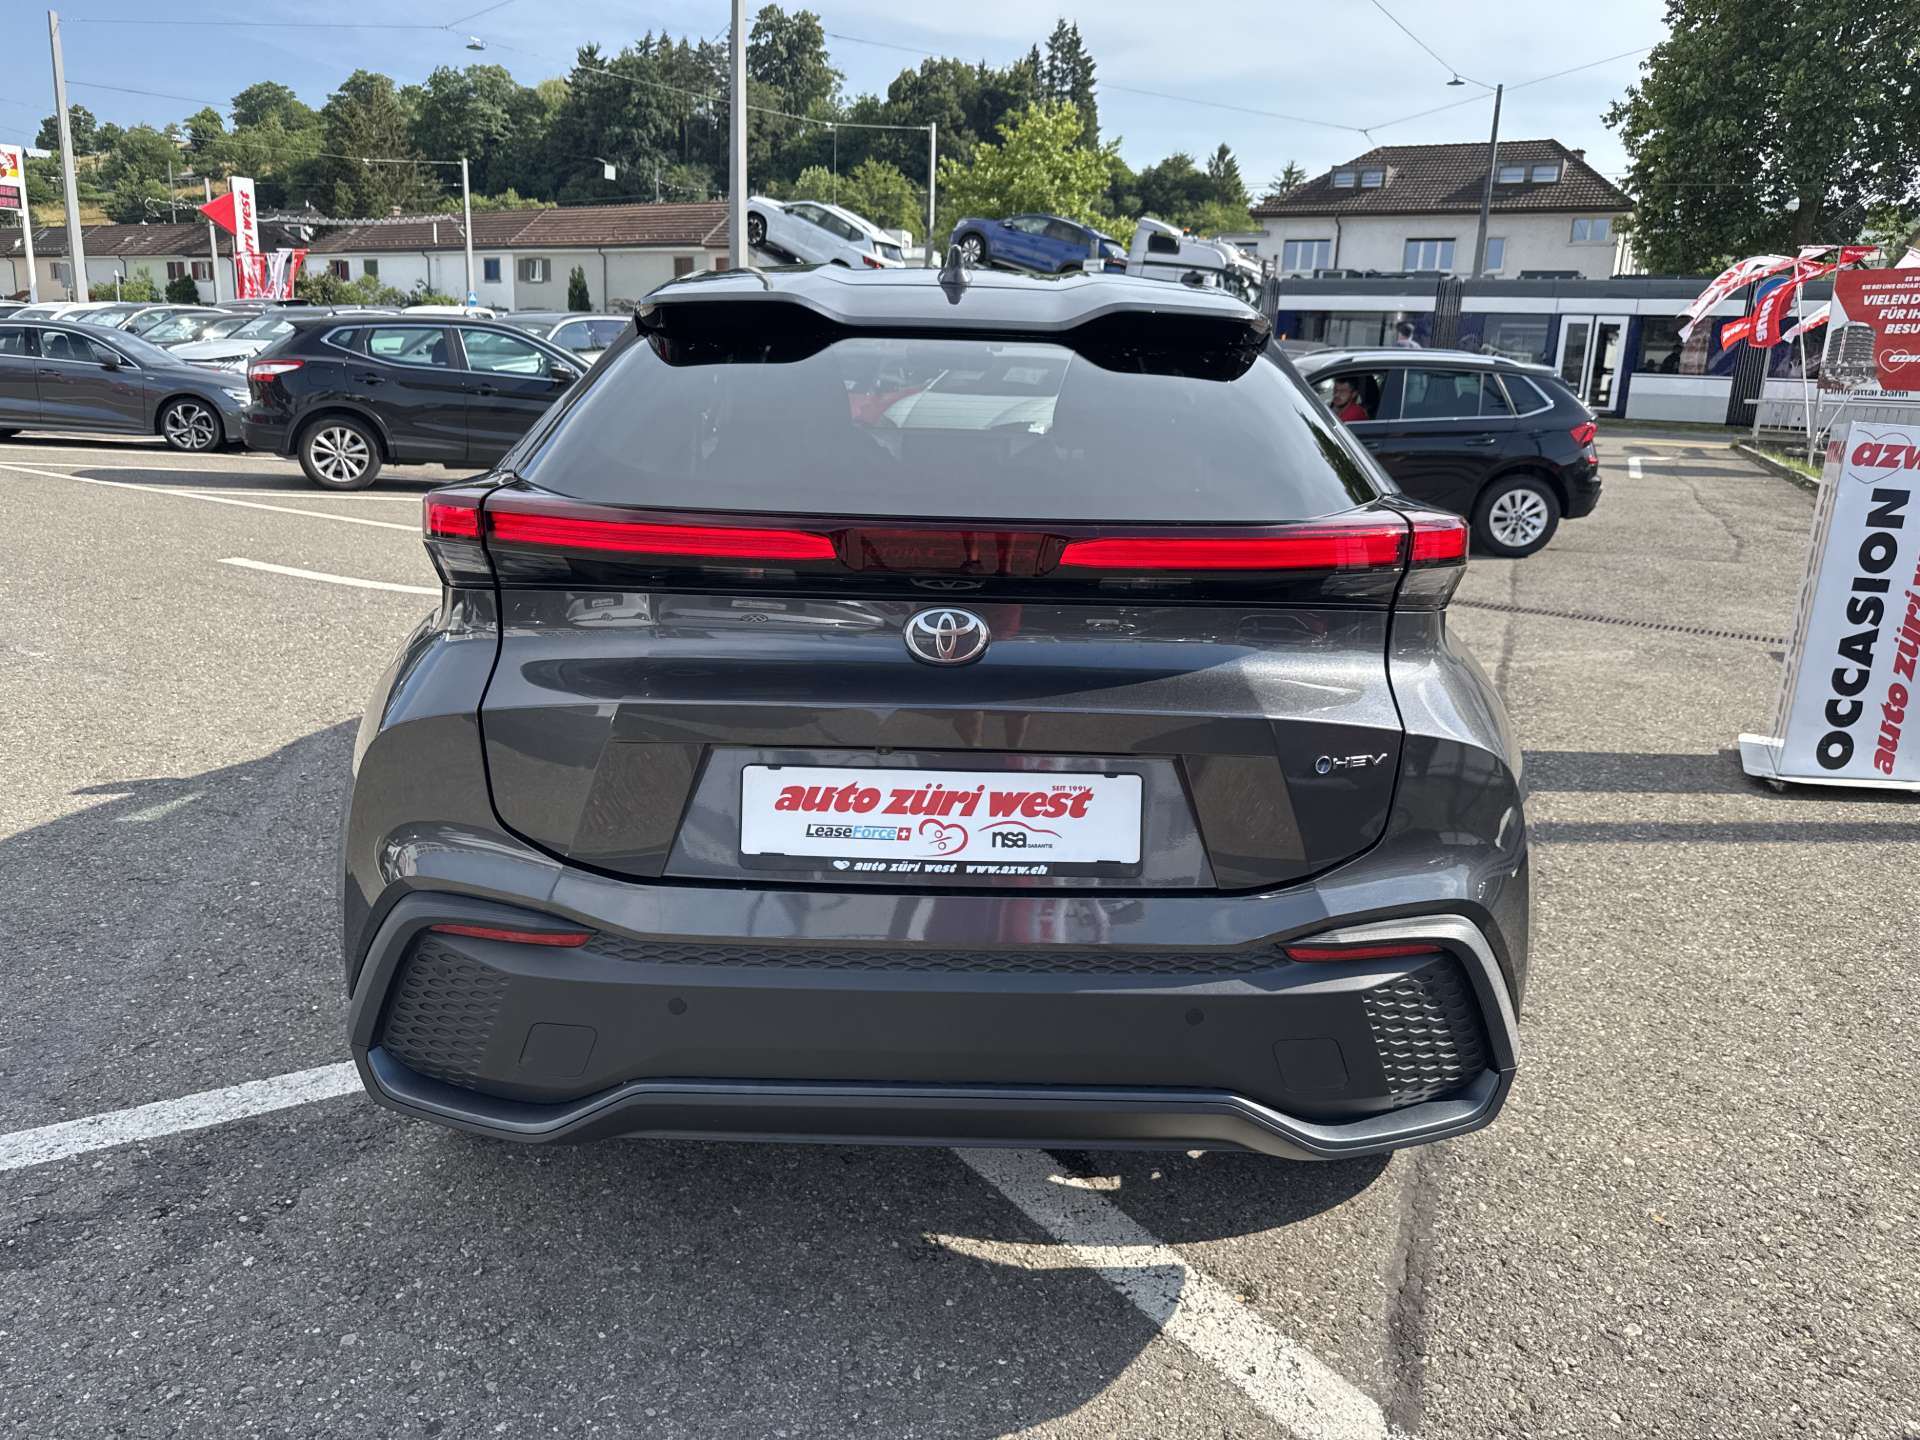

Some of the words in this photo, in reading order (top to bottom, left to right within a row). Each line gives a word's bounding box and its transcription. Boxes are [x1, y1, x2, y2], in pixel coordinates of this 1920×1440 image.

[239, 190, 253, 230] west
[1864, 294, 1910, 306] VIELEN
[1878, 306, 1907, 320] FÜR
[1816, 487, 1911, 771] OCCASION
[1873, 682, 1909, 776] auto
[1892, 589, 1920, 683] züri
[1068, 785, 1087, 793] 1991
[774, 780, 882, 814] auto
[881, 783, 986, 818] züri
[989, 786, 1095, 819] west
[805, 823, 898, 841] LeaseForce
[991, 831, 1027, 849] nsa
[853, 860, 887, 872] auto
[889, 860, 922, 873] züri
[924, 863, 958, 874] west
[965, 864, 1049, 876] www.azw.ch
